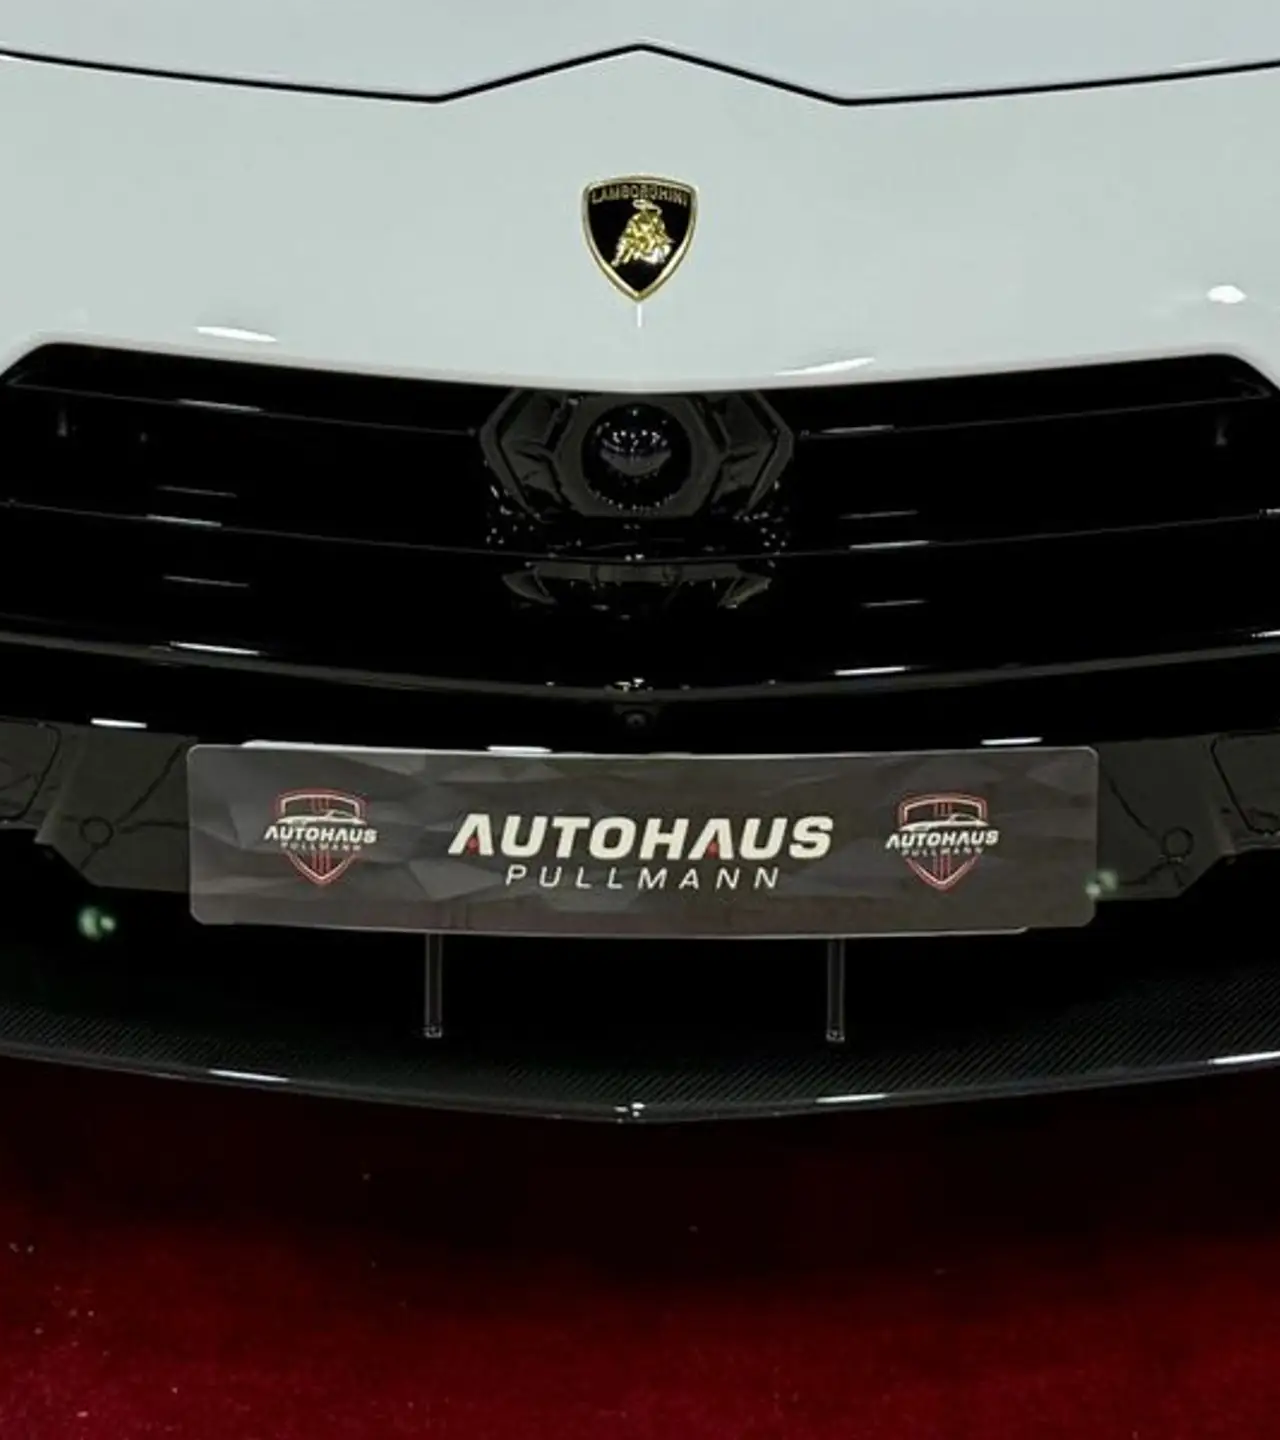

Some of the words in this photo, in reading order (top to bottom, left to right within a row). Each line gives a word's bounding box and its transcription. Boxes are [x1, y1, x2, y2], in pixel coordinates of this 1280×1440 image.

[264, 825, 378, 843] AUTOHAUS
[447, 813, 834, 860] AUTOHAUS
[885, 829, 1001, 850] AUTOHAUS
[505, 865, 780, 890] PULLMANN
